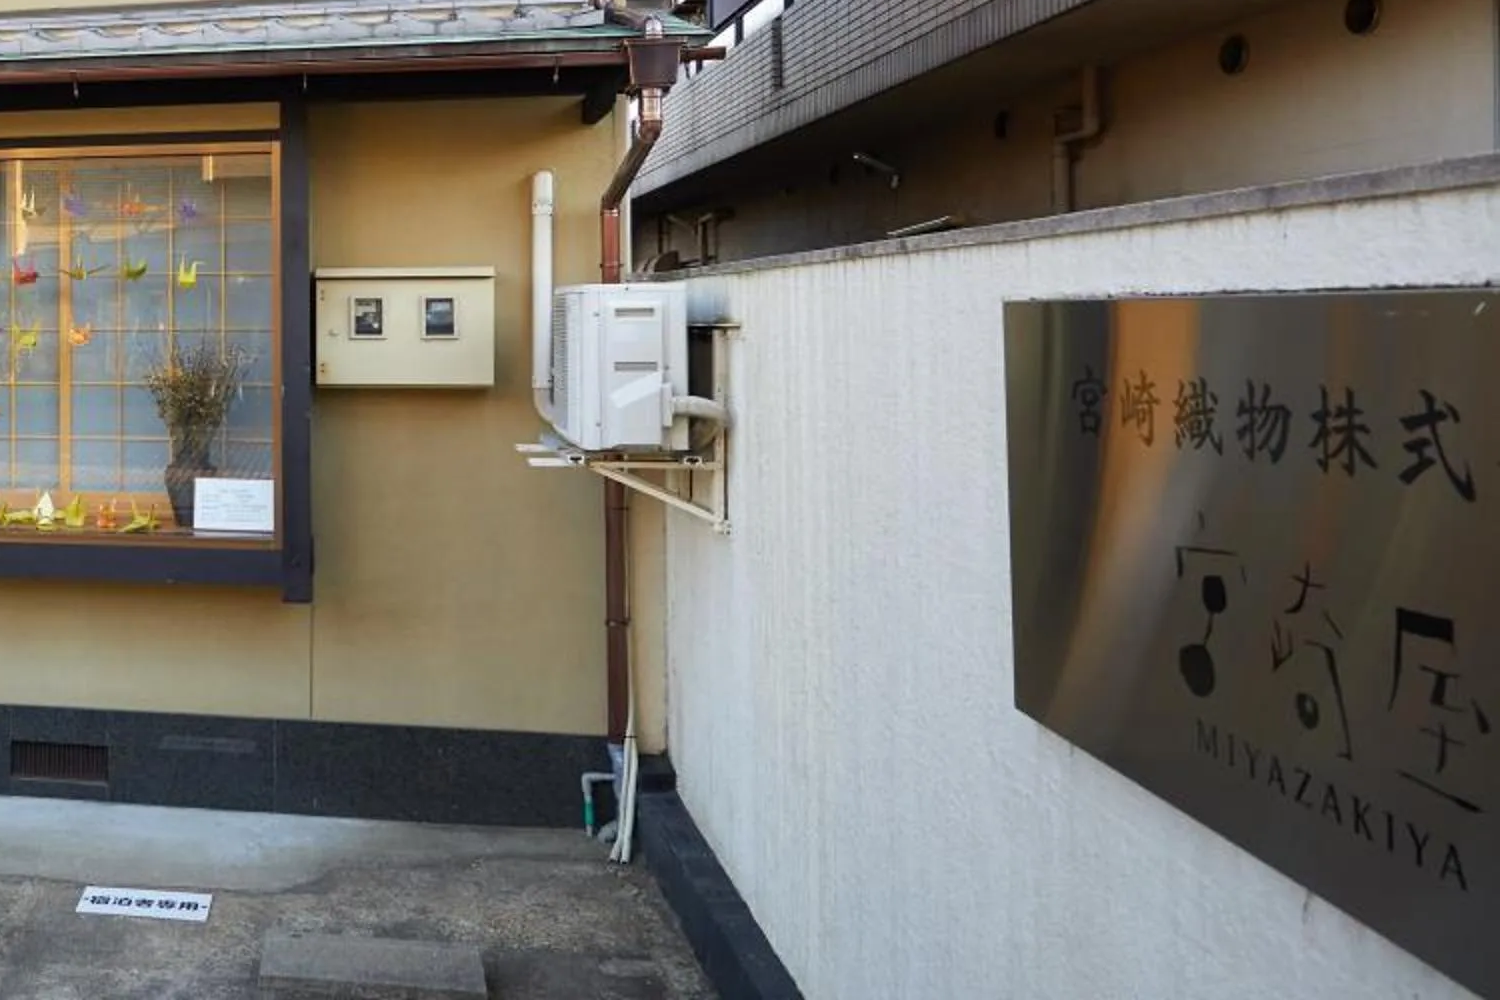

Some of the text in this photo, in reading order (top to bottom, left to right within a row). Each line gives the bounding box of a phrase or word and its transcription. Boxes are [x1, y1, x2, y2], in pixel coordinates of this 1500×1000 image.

[1071, 363, 1500, 503] 宮崎織物株式
[1196, 718, 1469, 891] MIYAZAKIYA
